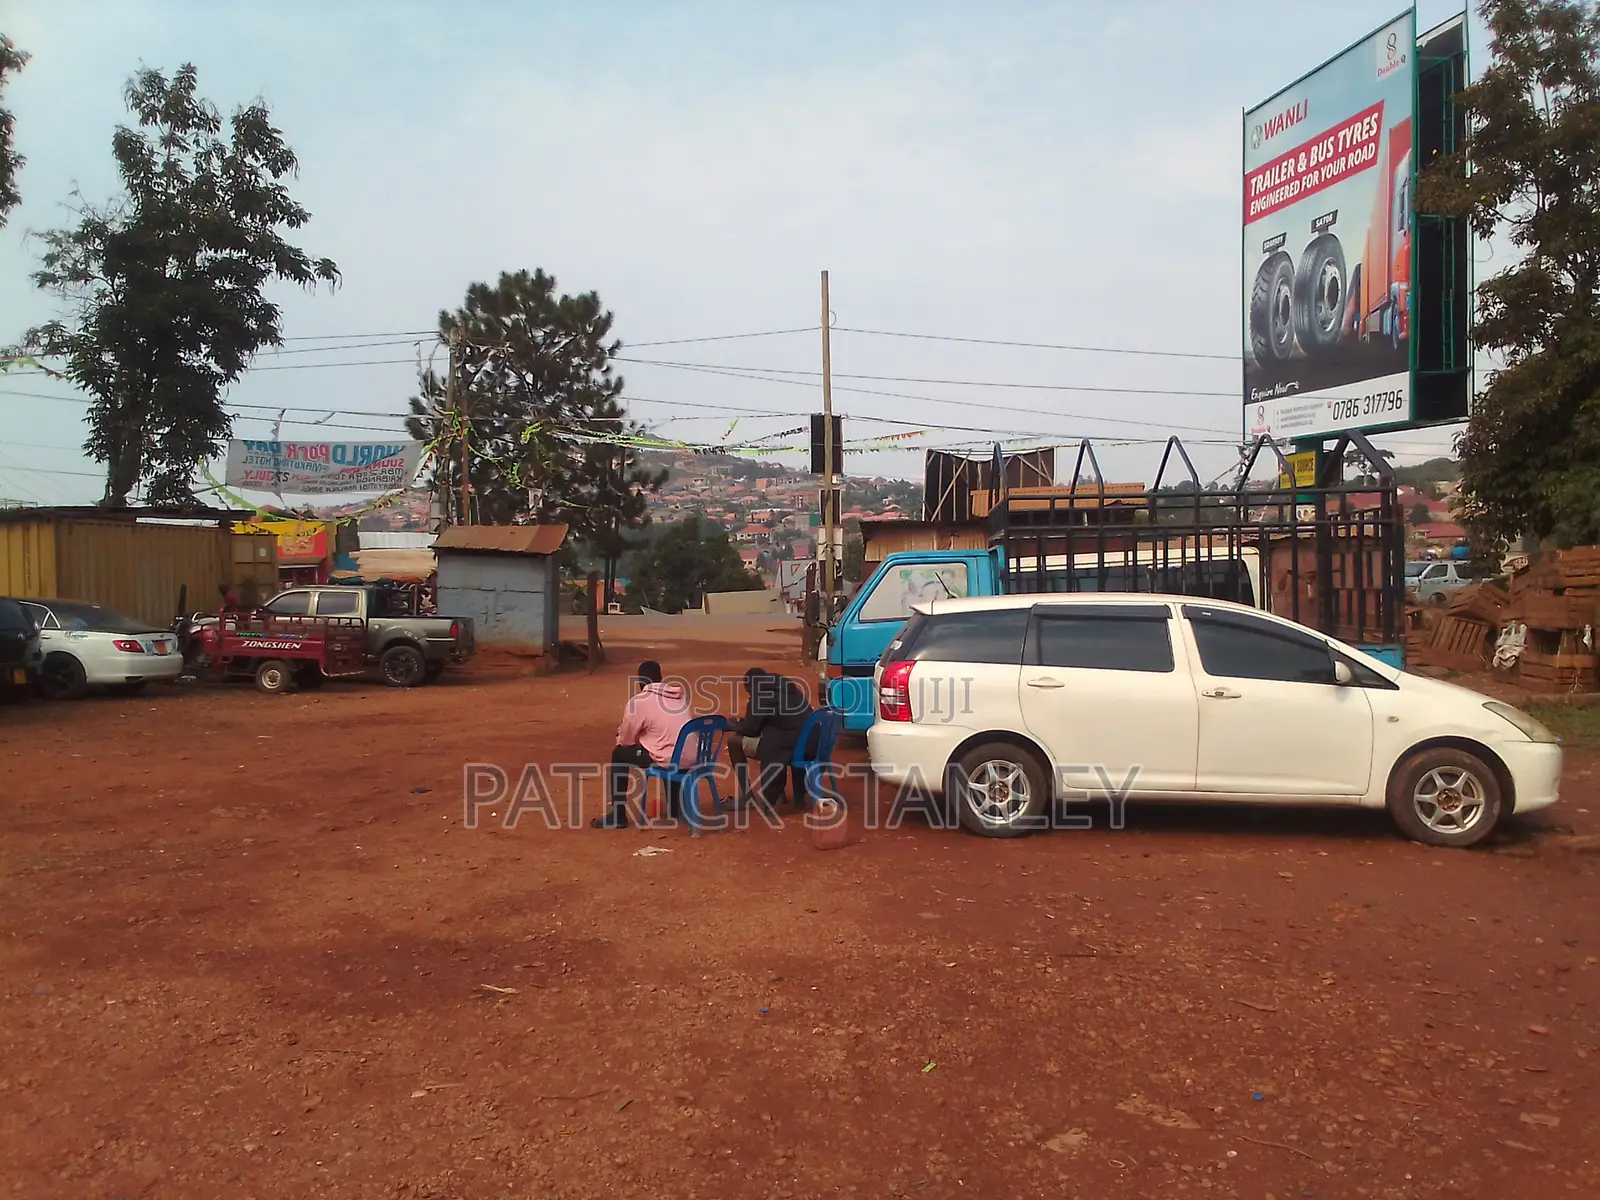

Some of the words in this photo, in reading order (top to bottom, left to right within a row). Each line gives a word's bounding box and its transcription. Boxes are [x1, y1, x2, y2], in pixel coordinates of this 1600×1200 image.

[1377, 59, 1400, 77] Double
[1264, 98, 1308, 141] WANLI
[1250, 157, 1295, 198] TRAILER
[1297, 151, 1308, 174] &
[1309, 135, 1335, 168] BUS
[1337, 112, 1379, 153] TYRES
[1249, 179, 1300, 216] ENGINEERED
[1301, 170, 1319, 192] FOR
[1320, 156, 1346, 183] YOUR
[1347, 142, 1376, 170] ROAD
[1332, 399, 1360, 421] 0786
[1363, 389, 1403, 415] 317796
[241, 640, 302, 650] ZONGSHEN
